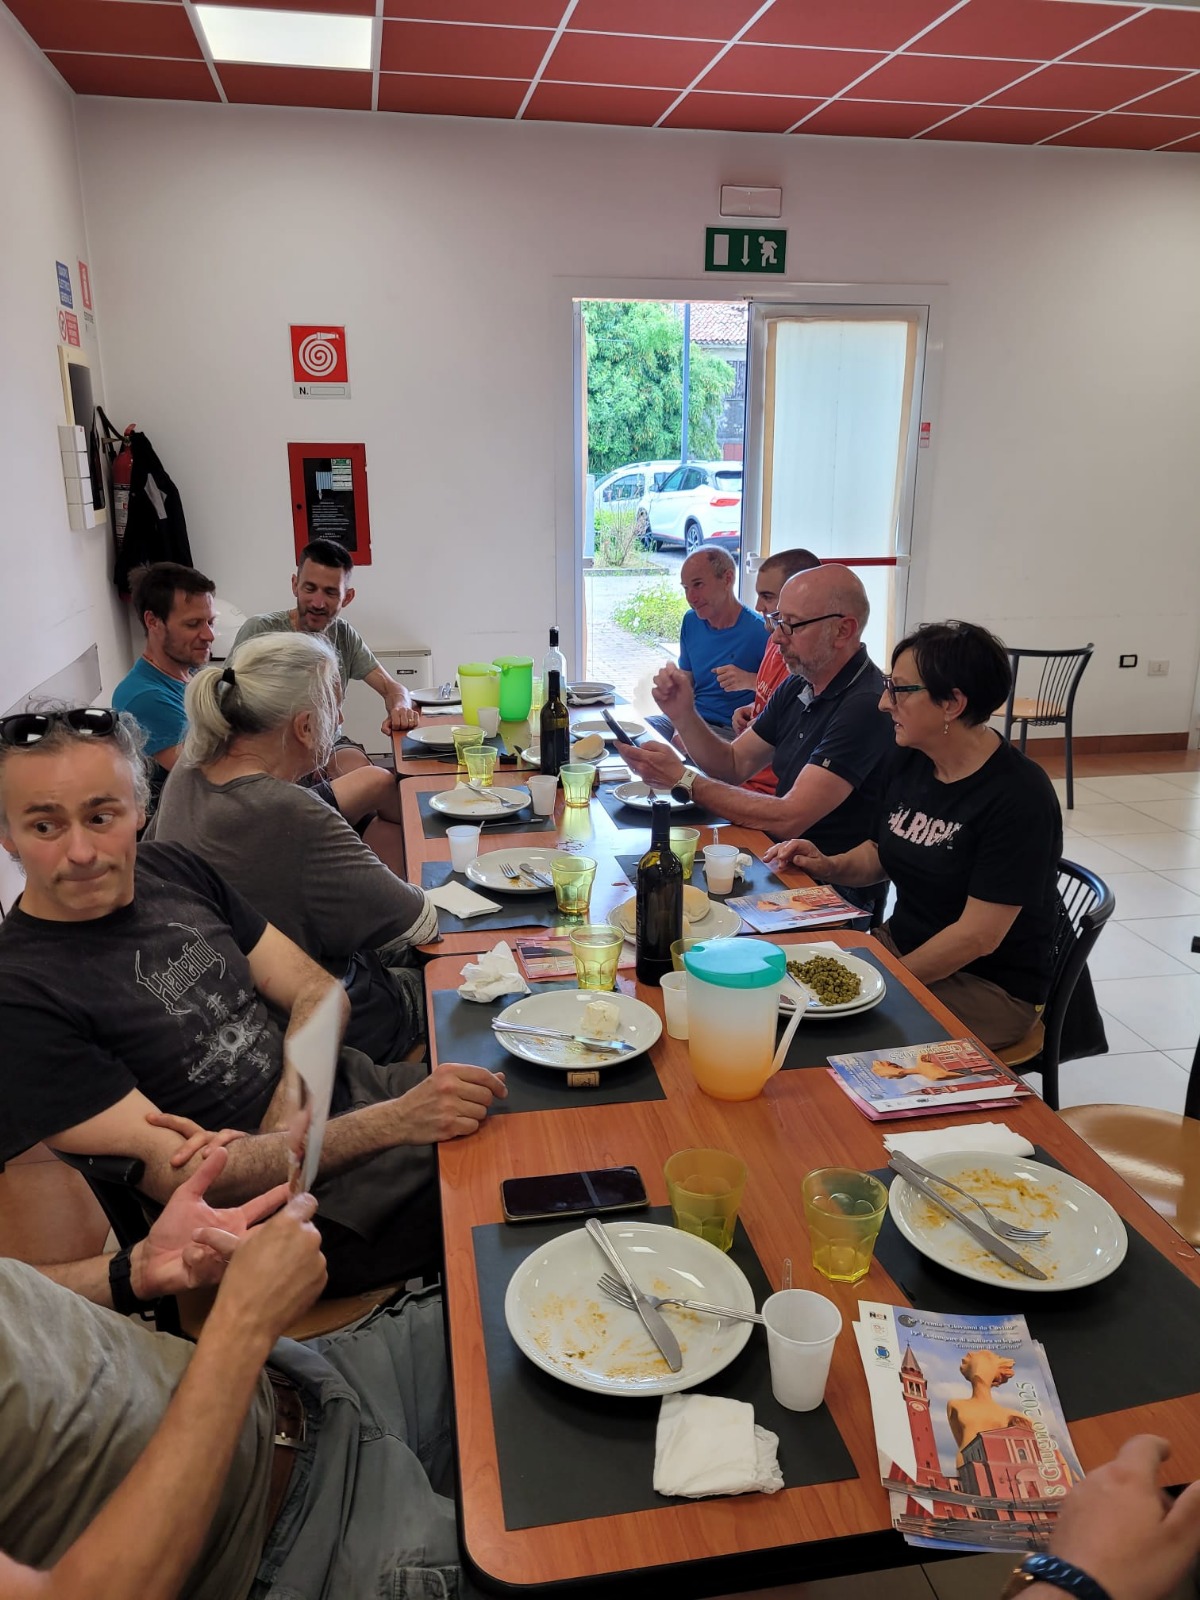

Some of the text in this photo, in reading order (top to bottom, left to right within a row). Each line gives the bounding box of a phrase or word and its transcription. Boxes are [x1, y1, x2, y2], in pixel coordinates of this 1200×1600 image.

[299, 386, 309, 395] N.
[1016, 1382, 1065, 1496] 8 Giugno 2025
